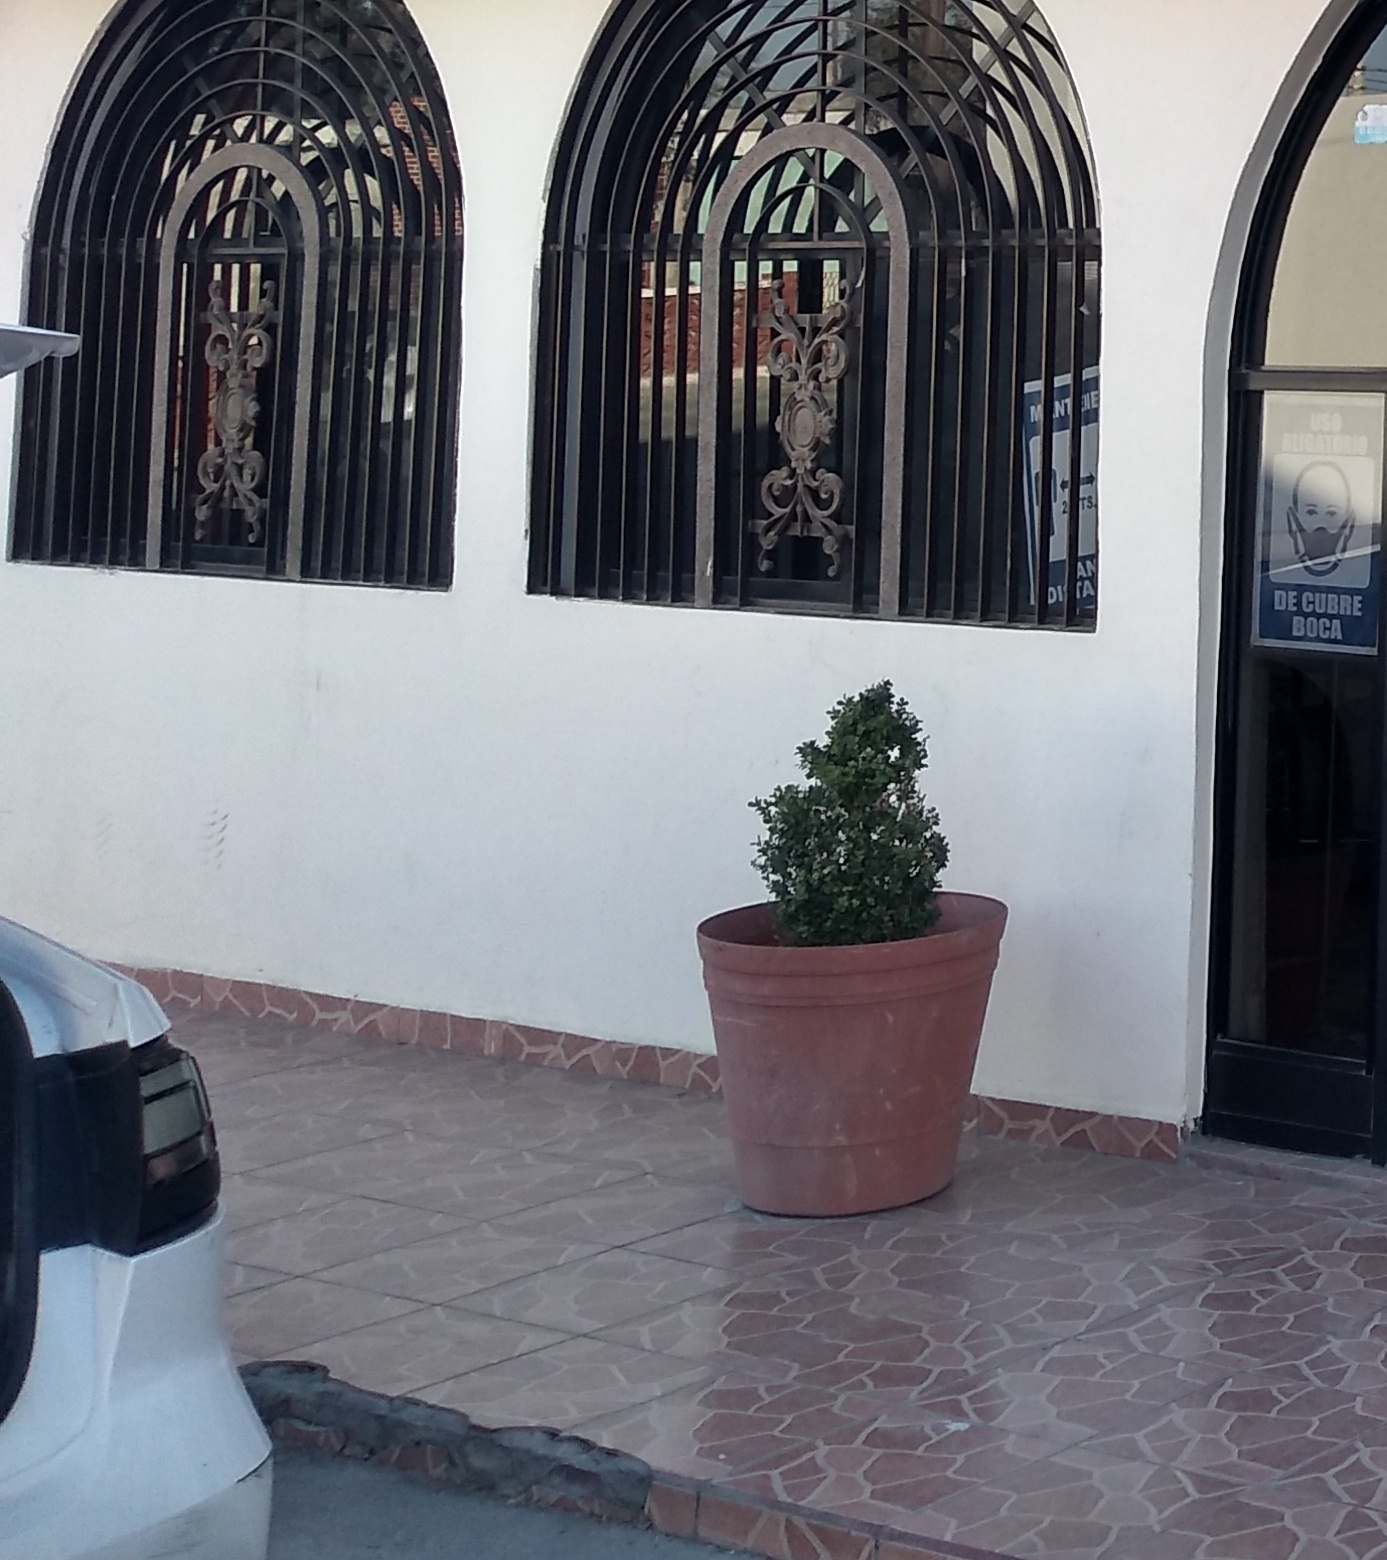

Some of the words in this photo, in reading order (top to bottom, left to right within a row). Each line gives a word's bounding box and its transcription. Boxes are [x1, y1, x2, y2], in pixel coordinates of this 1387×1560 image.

[1311, 412, 1342, 433] USO
[1273, 589, 1298, 612] DE
[1302, 591, 1363, 617] CUBRE
[1291, 615, 1343, 640] BOCA
